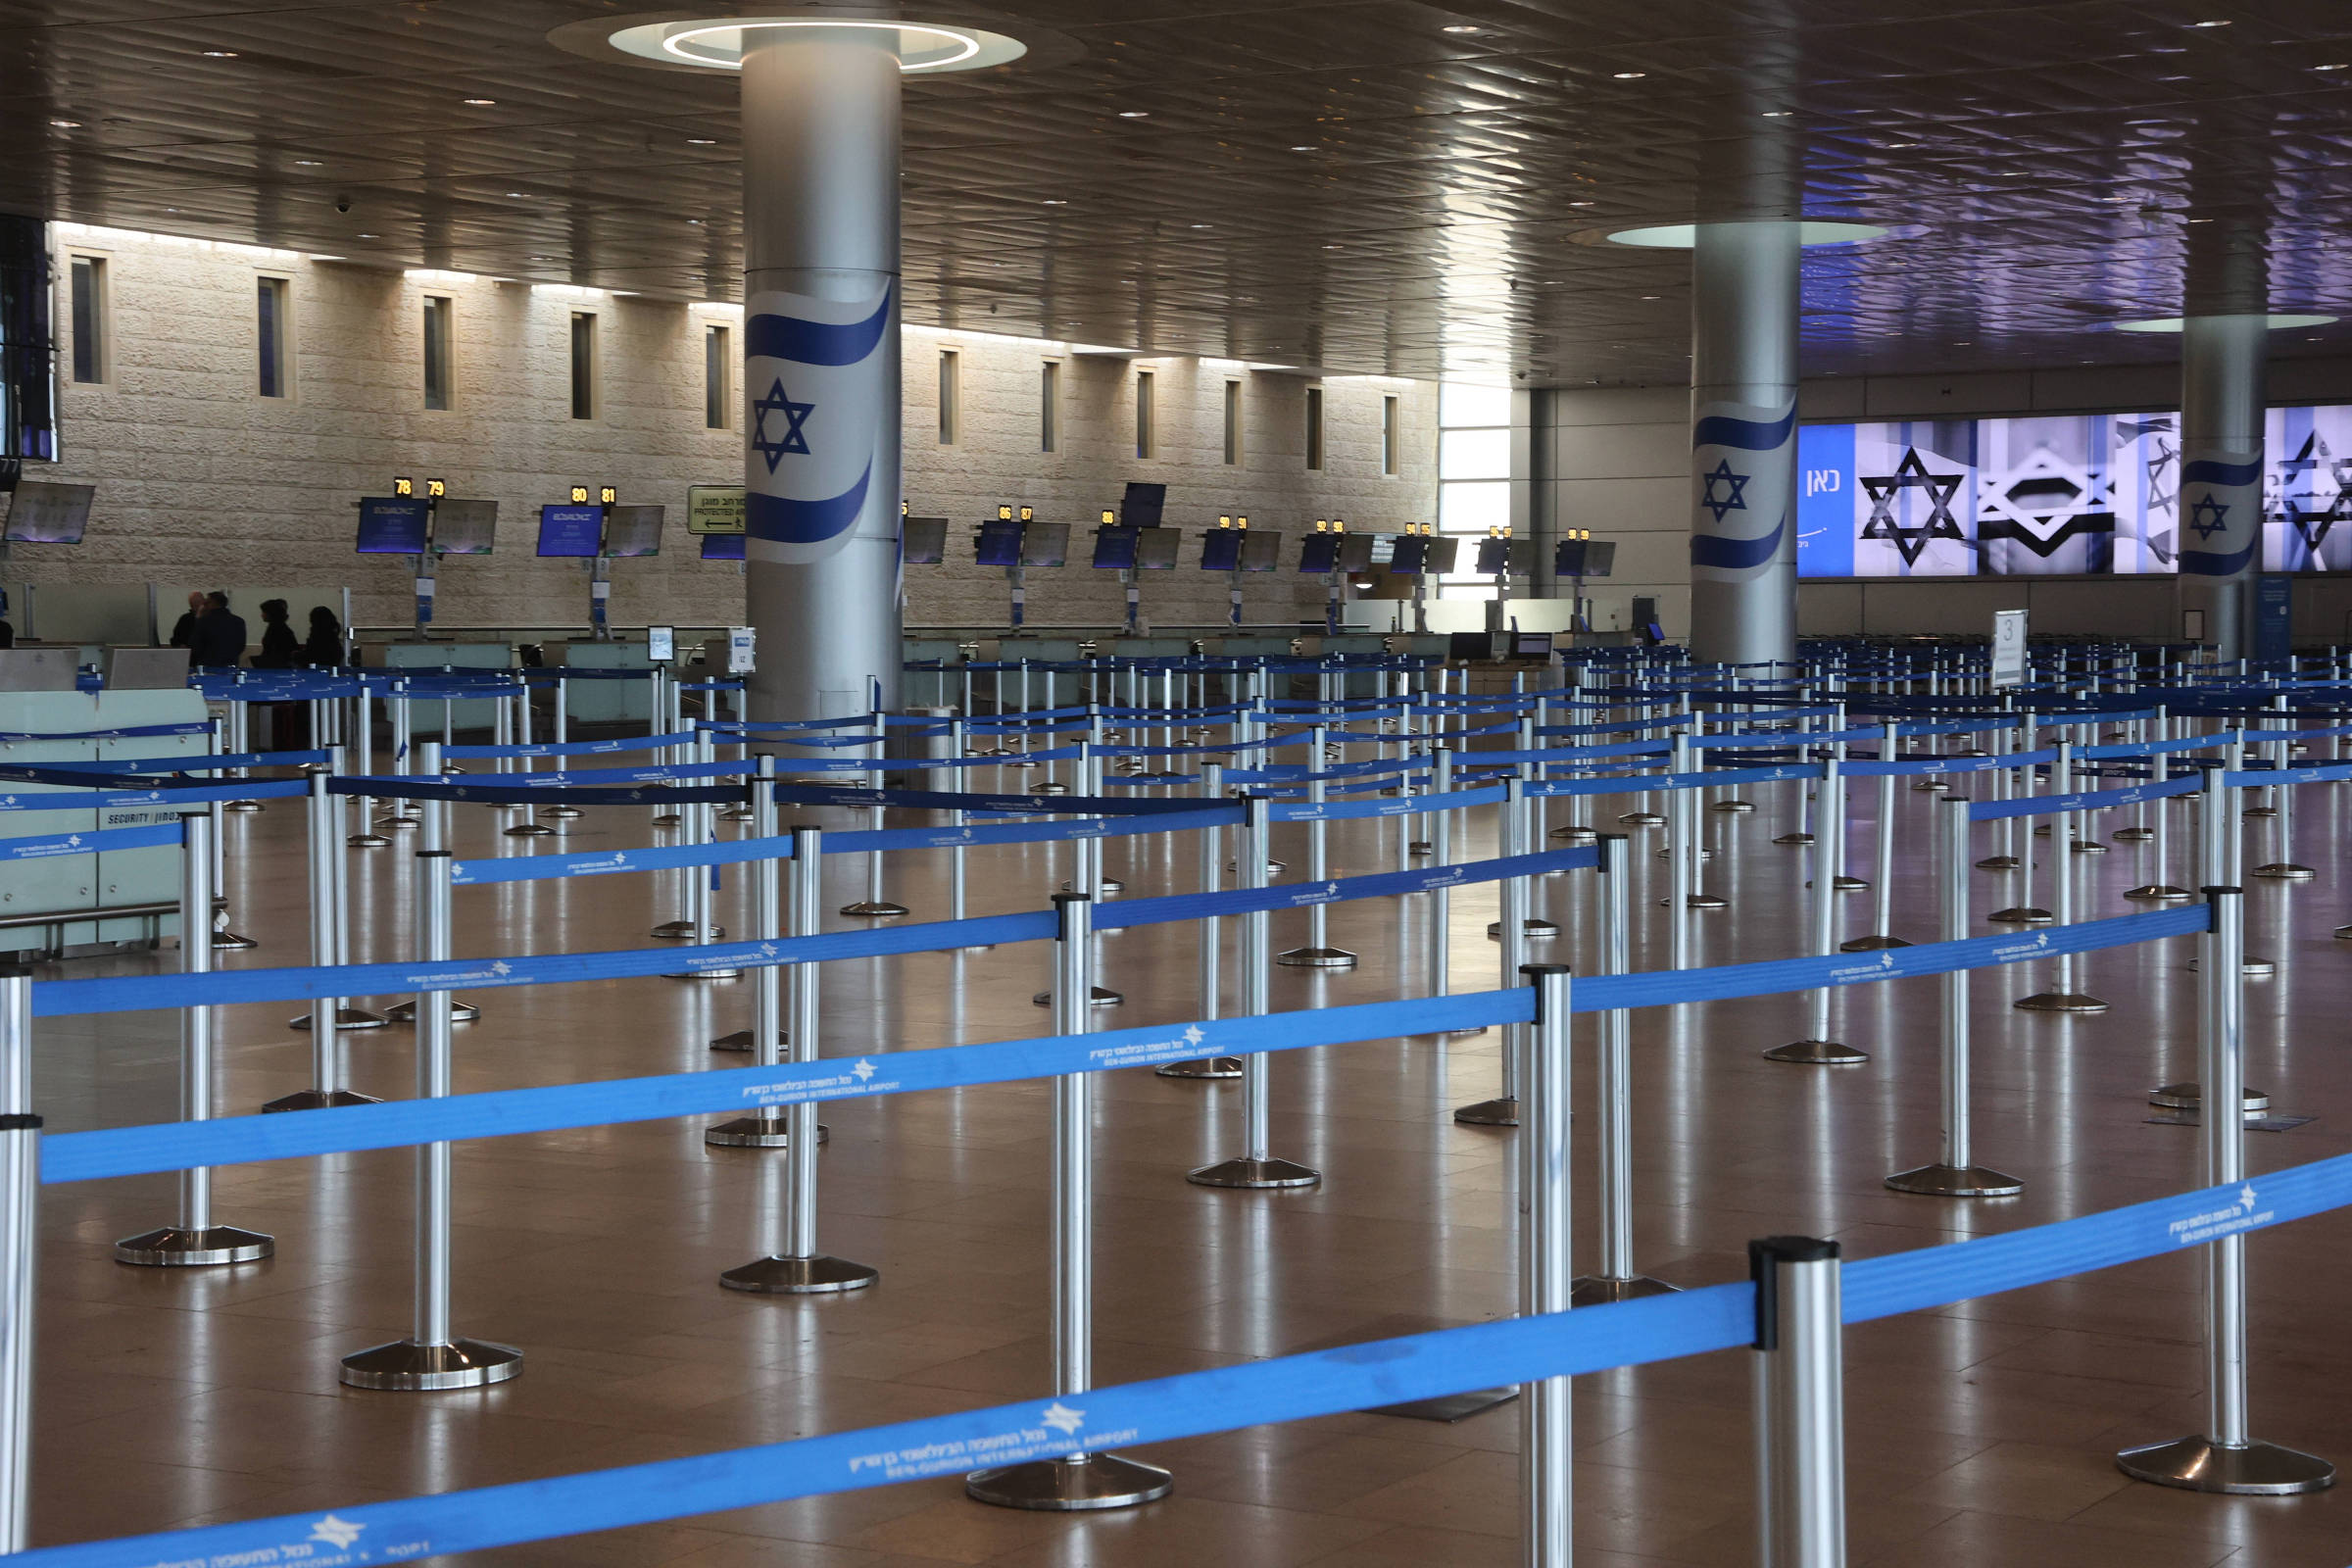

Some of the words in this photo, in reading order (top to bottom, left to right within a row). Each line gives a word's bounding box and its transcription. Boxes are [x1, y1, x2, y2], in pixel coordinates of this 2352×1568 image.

[394, 479, 412, 495] 78
[426, 480, 445, 496] 79
[1807, 469, 1840, 497] כאן
[571, 487, 588, 503] 80
[601, 488, 615, 503] 81
[999, 506, 1011, 520] 86
[1020, 507, 1033, 520] 87
[1102, 511, 1114, 524] 88
[1219, 515, 1230, 529] 90
[1238, 516, 1248, 529] 91
[1316, 519, 1327, 532] 92
[2003, 618, 2014, 642] 3
[108, 812, 150, 824] SECURITY
[1198, 1046, 1225, 1055] AIRPORT
[808, 1085, 866, 1099] INTERNATIONAL
[867, 1082, 901, 1092] AIRPORT
[886, 1455, 974, 1479] BEN-GURION
[1083, 1427, 1139, 1449] AIRPORT
